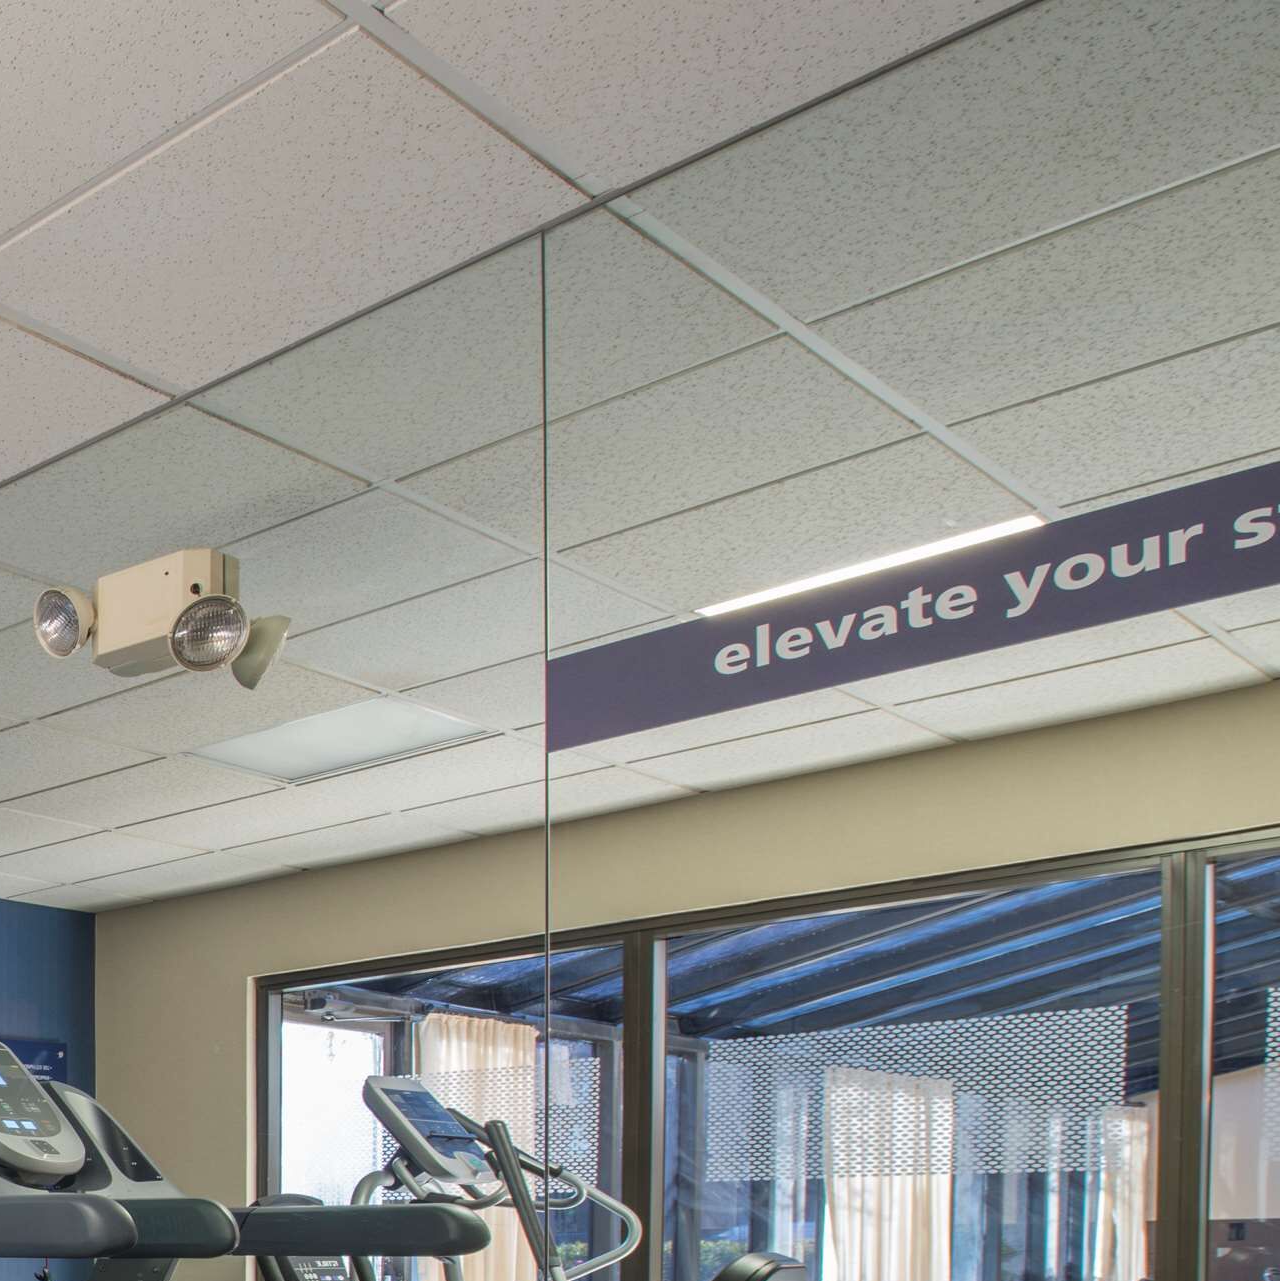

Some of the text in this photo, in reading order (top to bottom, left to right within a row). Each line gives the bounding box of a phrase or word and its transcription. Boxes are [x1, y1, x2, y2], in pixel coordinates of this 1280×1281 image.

[714, 504, 1280, 675] elevate your s
